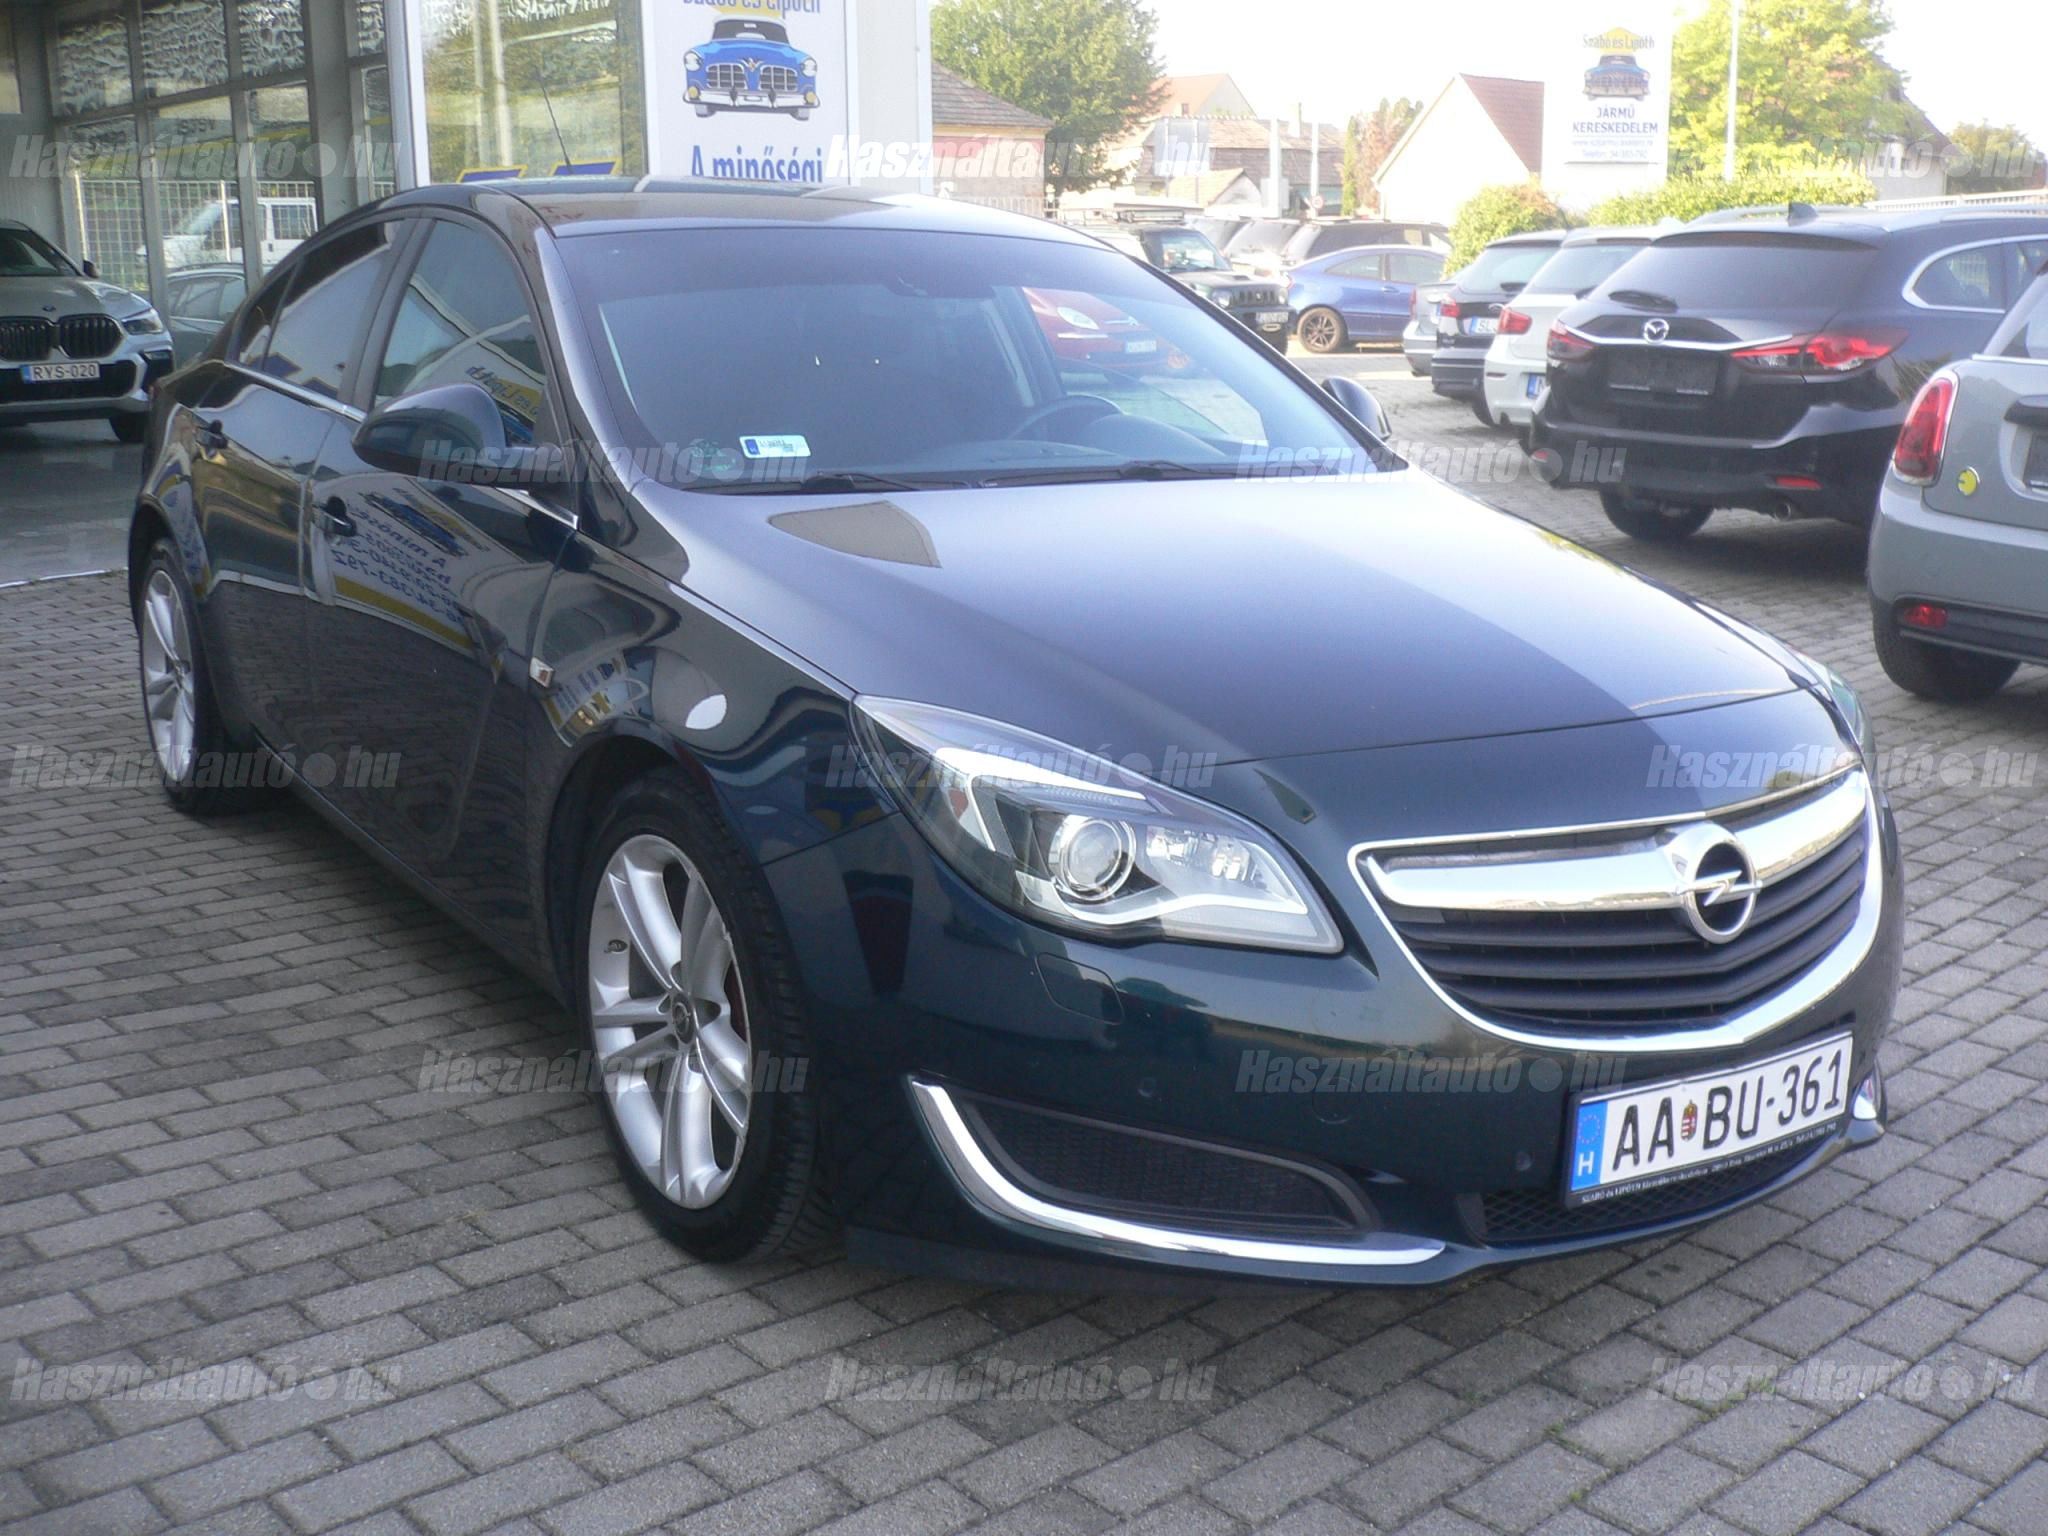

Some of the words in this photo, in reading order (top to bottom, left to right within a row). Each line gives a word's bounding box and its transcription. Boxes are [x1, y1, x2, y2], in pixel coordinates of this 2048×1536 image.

[1572, 122, 1658, 133] KERESKEDELEM
[692, 145, 704, 177] A
[33, 364, 97, 380] RYS-020
[1613, 1097, 1674, 1171] AA
[1702, 1049, 1842, 1150] BU-361
[1577, 1151, 1595, 1177] H
